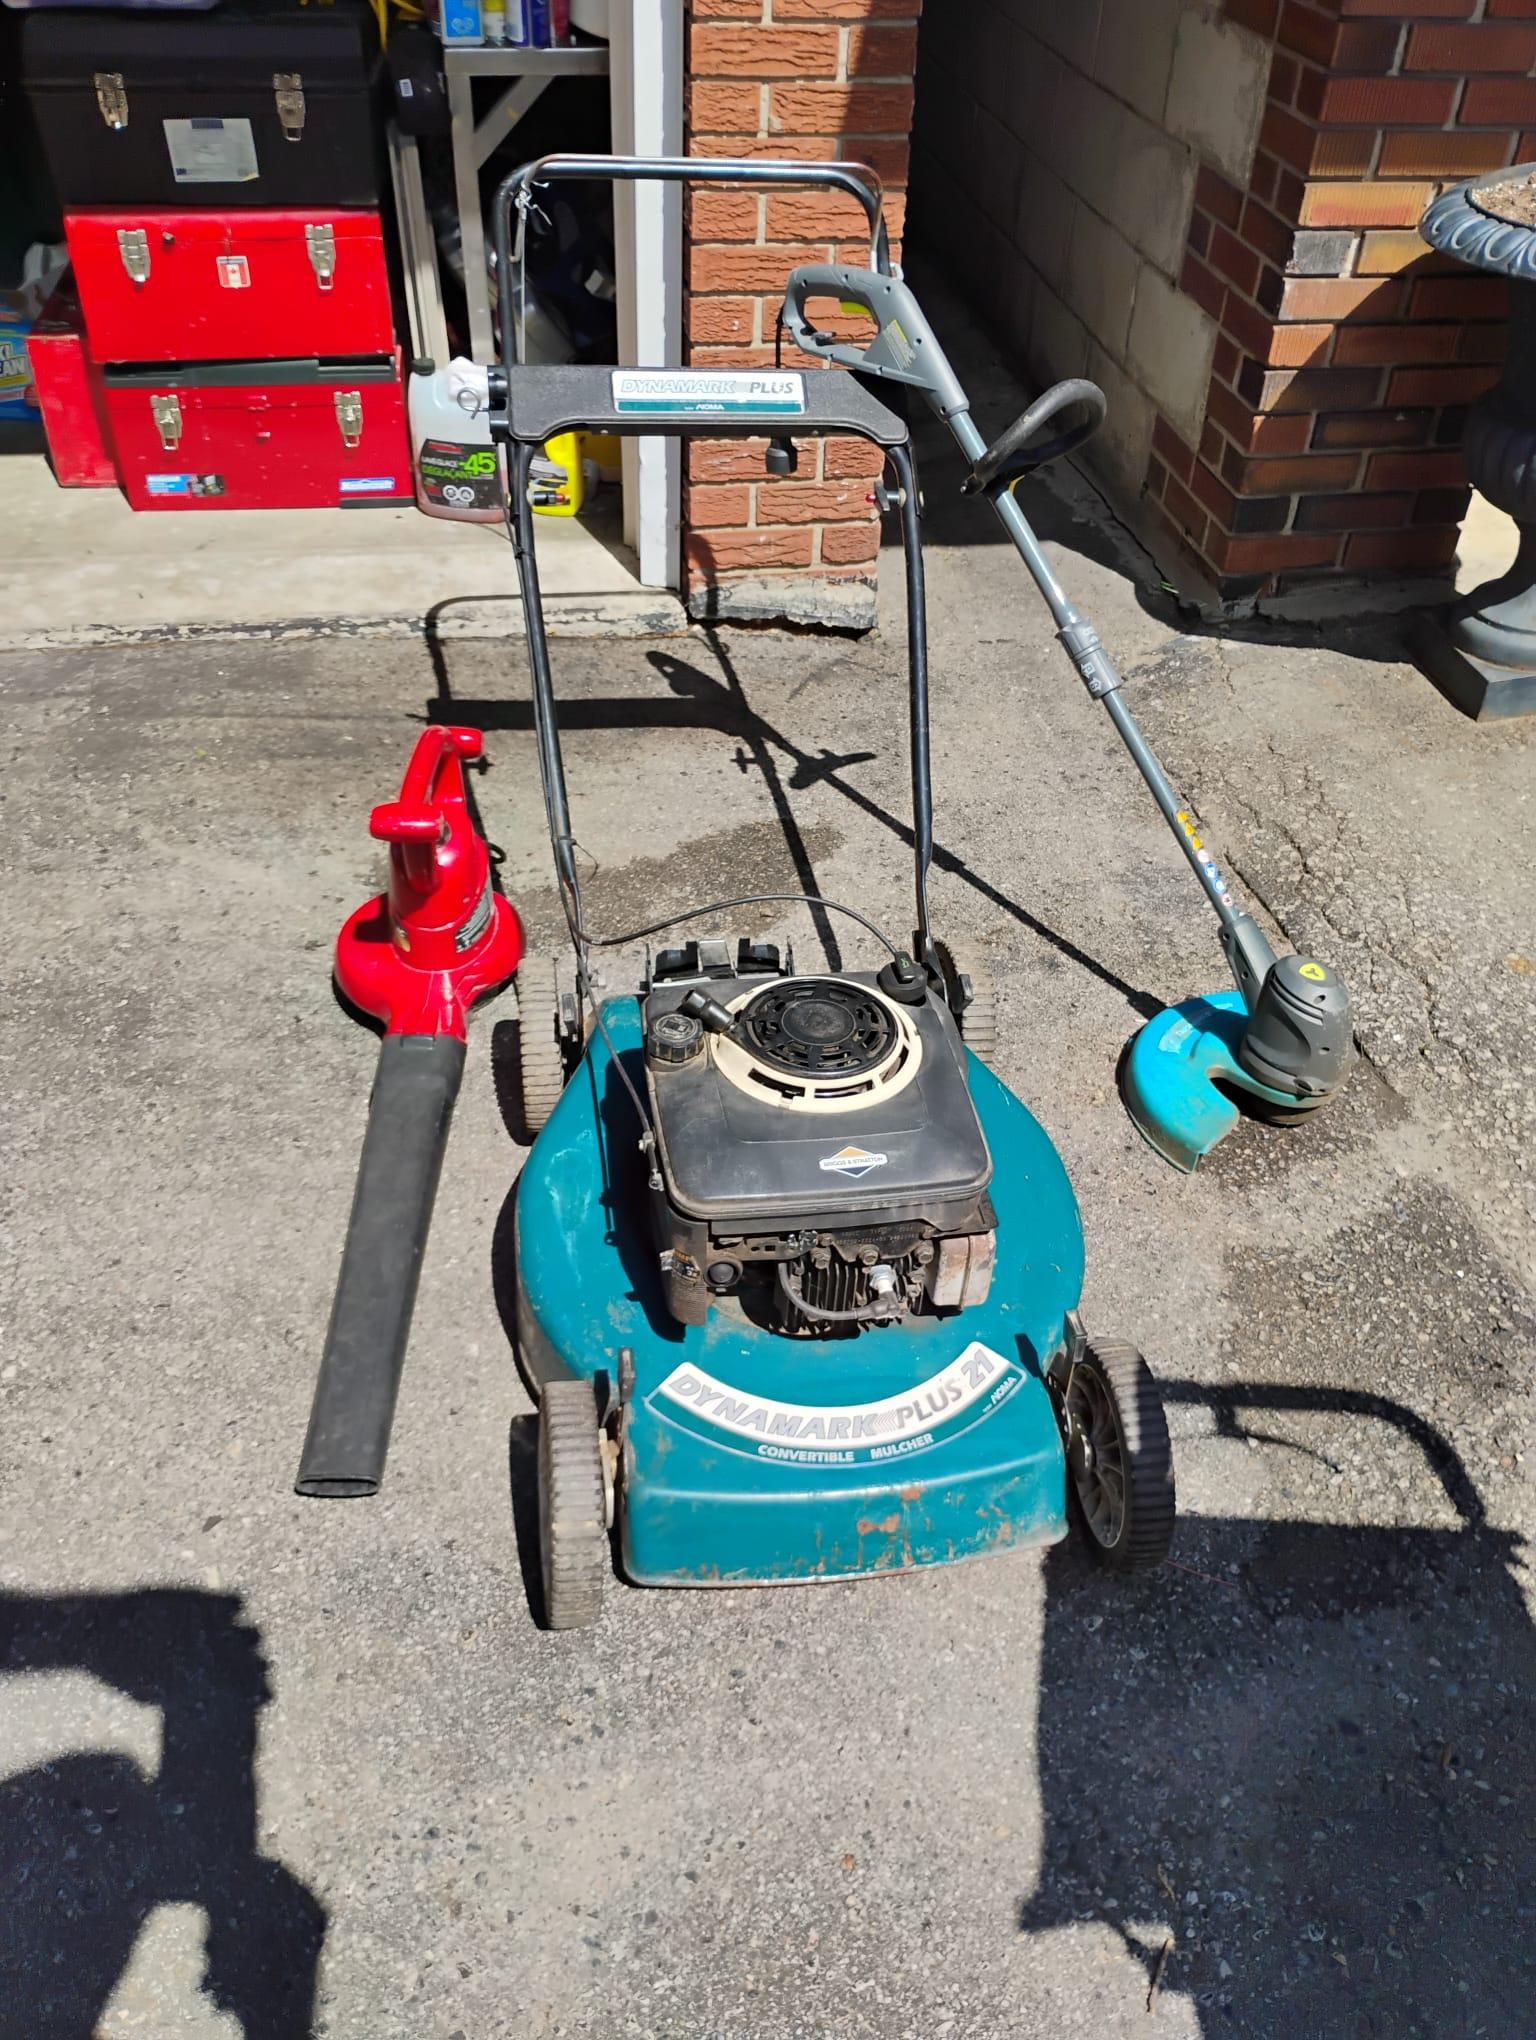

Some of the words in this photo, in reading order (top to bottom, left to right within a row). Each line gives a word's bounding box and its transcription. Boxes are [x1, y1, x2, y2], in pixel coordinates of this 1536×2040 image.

[620, 379, 735, 394] DYNAMARK
[750, 381, 794, 394] PLUS
[668, 1373, 877, 1440] DYNAMARK
[897, 1379, 963, 1429] PLUS
[961, 1348, 996, 1390] 21
[757, 1443, 855, 1464] CONVERTIBLE
[870, 1432, 934, 1460] MULCHER
